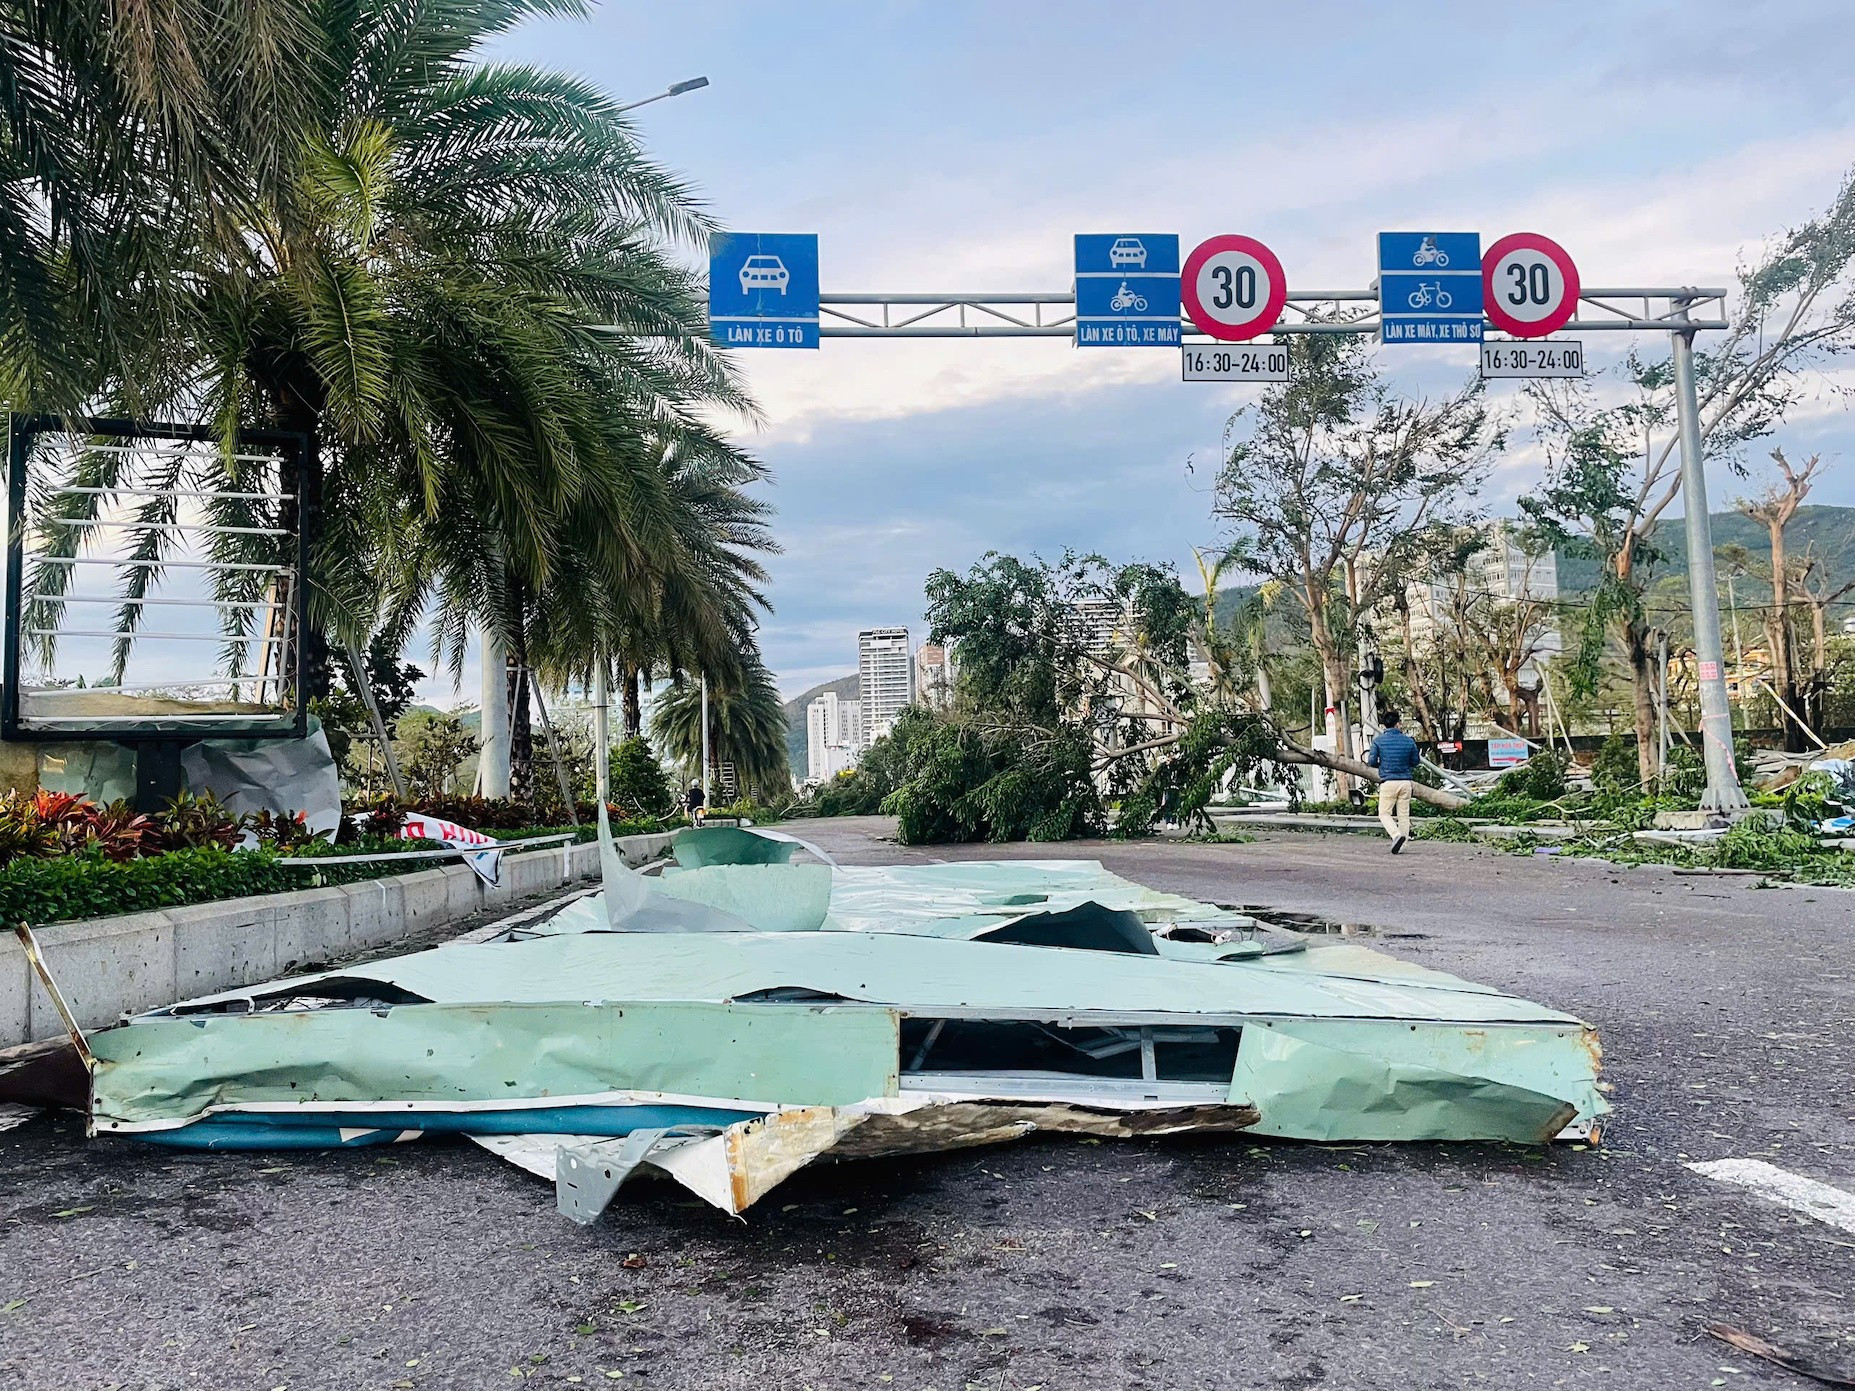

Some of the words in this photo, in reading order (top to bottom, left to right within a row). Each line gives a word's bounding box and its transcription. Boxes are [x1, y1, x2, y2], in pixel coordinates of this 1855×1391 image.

[1212, 265, 1257, 309] 30
[1507, 263, 1550, 305] 30
[728, 324, 753, 342] LÀN
[756, 328, 773, 343] XE
[775, 325, 785, 343] Ô
[788, 325, 804, 343] TÔ
[1080, 324, 1100, 342] LÀN
[1102, 327, 1115, 342] XE
[1116, 324, 1124, 342] Ô
[1125, 324, 1141, 343] TÔ,
[1143, 327, 1156, 342] XE
[1157, 324, 1179, 342] MÁY
[1385, 321, 1403, 339] LÀN
[1404, 324, 1416, 339] XE
[1417, 321, 1439, 340] MÁY,
[1439, 324, 1450, 339] XE
[1451, 321, 1468, 339] THÔ
[1469, 322, 1481, 339] SƠ
[1185, 352, 1286, 374] 16:30-24:00
[1485, 349, 1581, 371] 16:30-24:00
